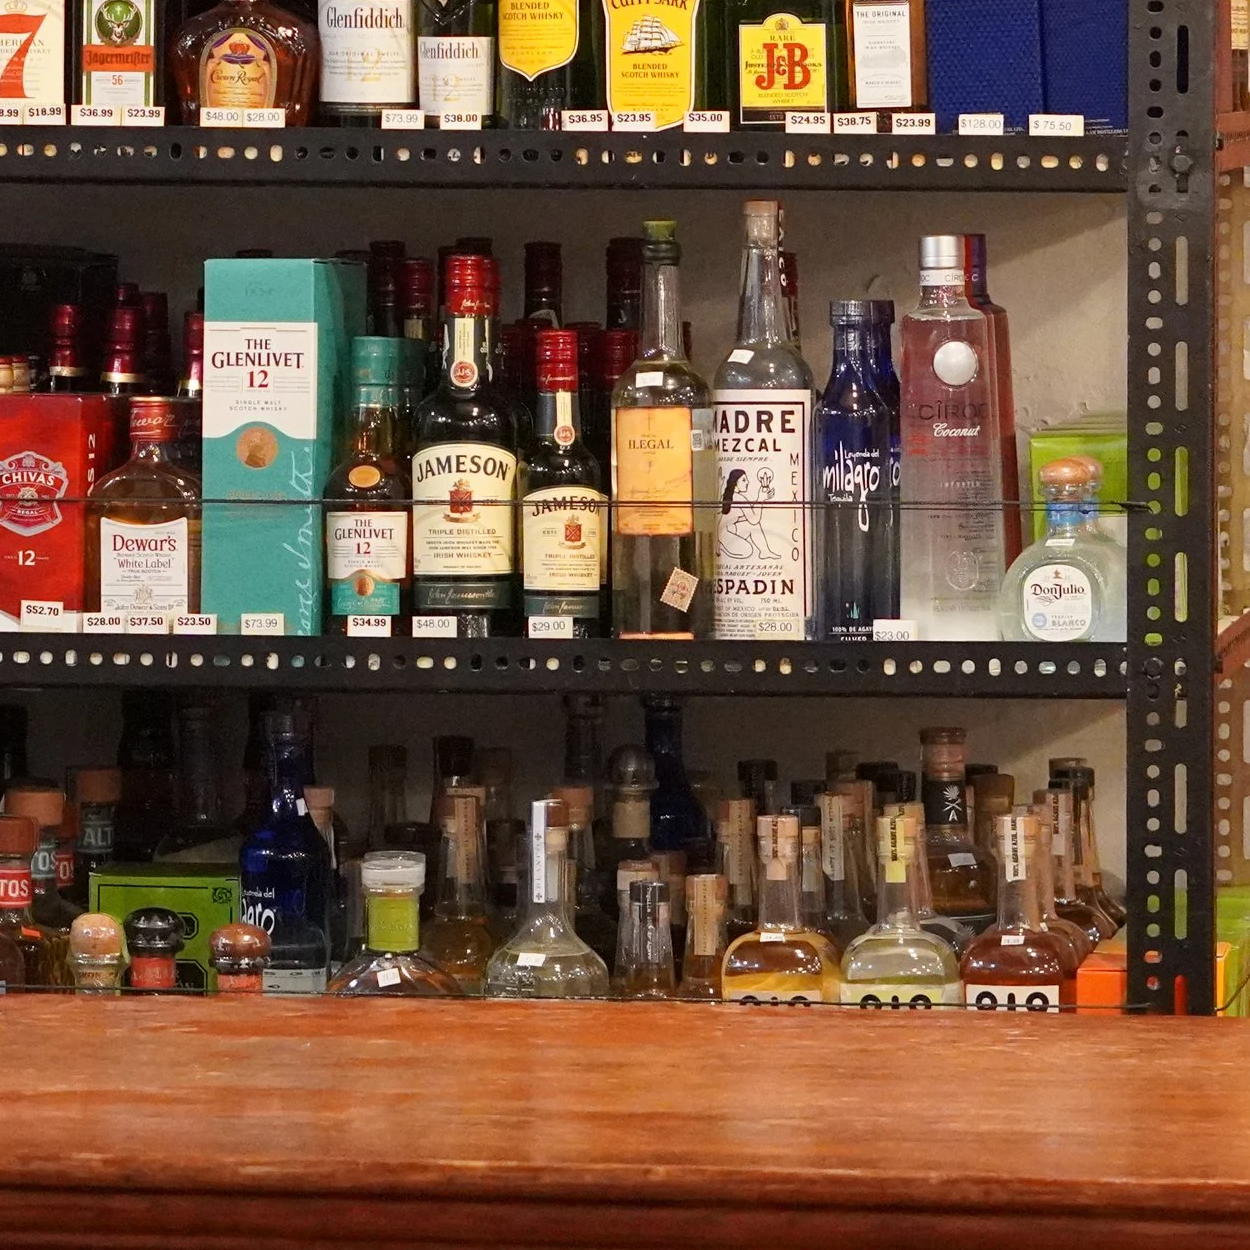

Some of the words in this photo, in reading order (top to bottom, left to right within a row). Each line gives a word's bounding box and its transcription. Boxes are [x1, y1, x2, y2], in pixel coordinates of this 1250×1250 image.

[510, 1, 550, 10] BLENDED
[326, 6, 403, 29] Glenfiddich
[632, 63, 668, 71] BLENDED
[621, 71, 649, 79] SCOTCH
[650, 71, 680, 79] WHISKY
[79, 107, 113, 118] $36.99
[205, 110, 239, 121] $48.00
[384, 113, 419, 123] $73.99
[616, 112, 651, 123] $23.95
[688, 112, 723, 123] $35.00
[790, 114, 826, 125] $24.95
[837, 116, 871, 127] $38.75
[244, 338, 271, 350] THE
[211, 351, 304, 369] GLENLIVET
[246, 370, 269, 389] 12
[932, 422, 982, 439] Coconut
[417, 454, 509, 483] JAMESON
[2, 472, 55, 487] CHIVAS
[354, 518, 373, 527] THE
[334, 528, 394, 540] GLENLIVET
[112, 534, 177, 552] Dewar's
[354, 541, 371, 555] 12
[17, 550, 36, 566] 12
[25, 604, 60, 617] $52.70
[130, 616, 164, 626] $37.50
[244, 618, 278, 629] $73.99
[416, 619, 450, 630] $48.00
[757, 621, 793, 633] $28.00
